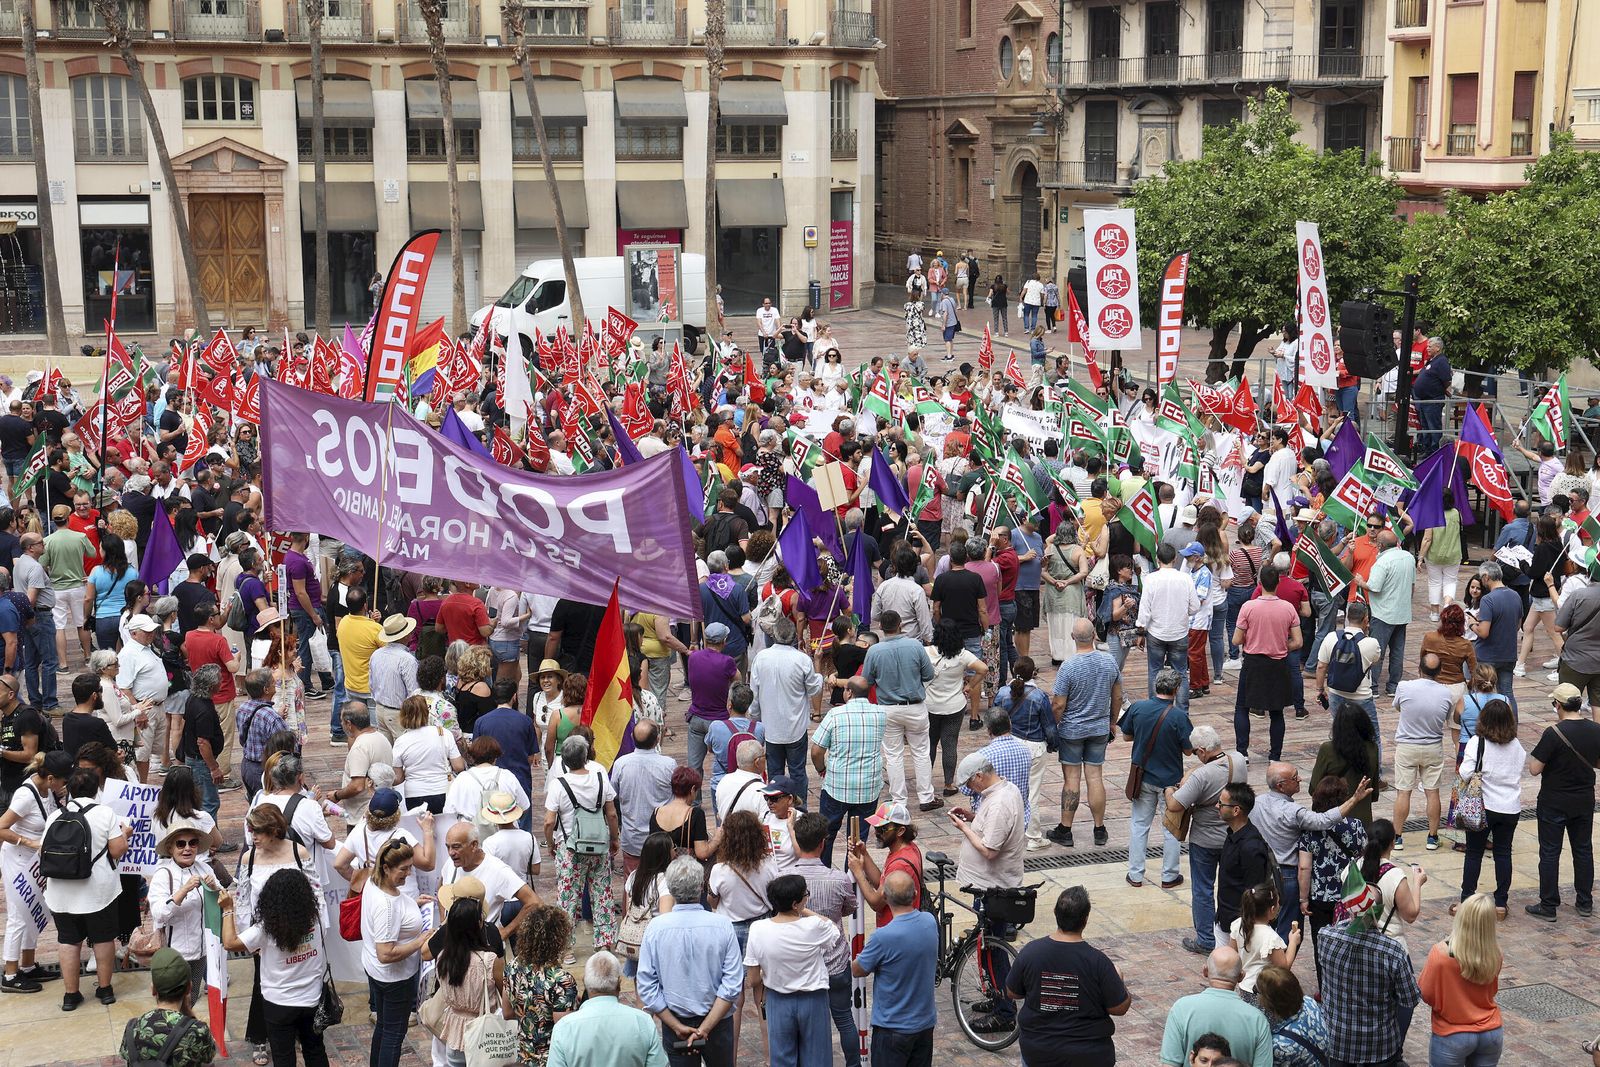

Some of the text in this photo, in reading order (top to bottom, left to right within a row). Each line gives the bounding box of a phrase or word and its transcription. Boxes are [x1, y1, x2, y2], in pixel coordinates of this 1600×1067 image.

[1101, 229, 1121, 241] UGT
[1103, 269, 1122, 281] UGT
[378, 250, 424, 380] CCOO
[1105, 309, 1124, 321] UGT
[1159, 278, 1185, 378] CCOO
[120, 784, 160, 802] APOY
[122, 865, 141, 873] IRAN
[13, 872, 48, 934] PARA IRAN
[286, 948, 318, 965] LIBERTAD
[478, 1039, 506, 1050] WHISKEY
[489, 1052, 514, 1060] JAMESON
